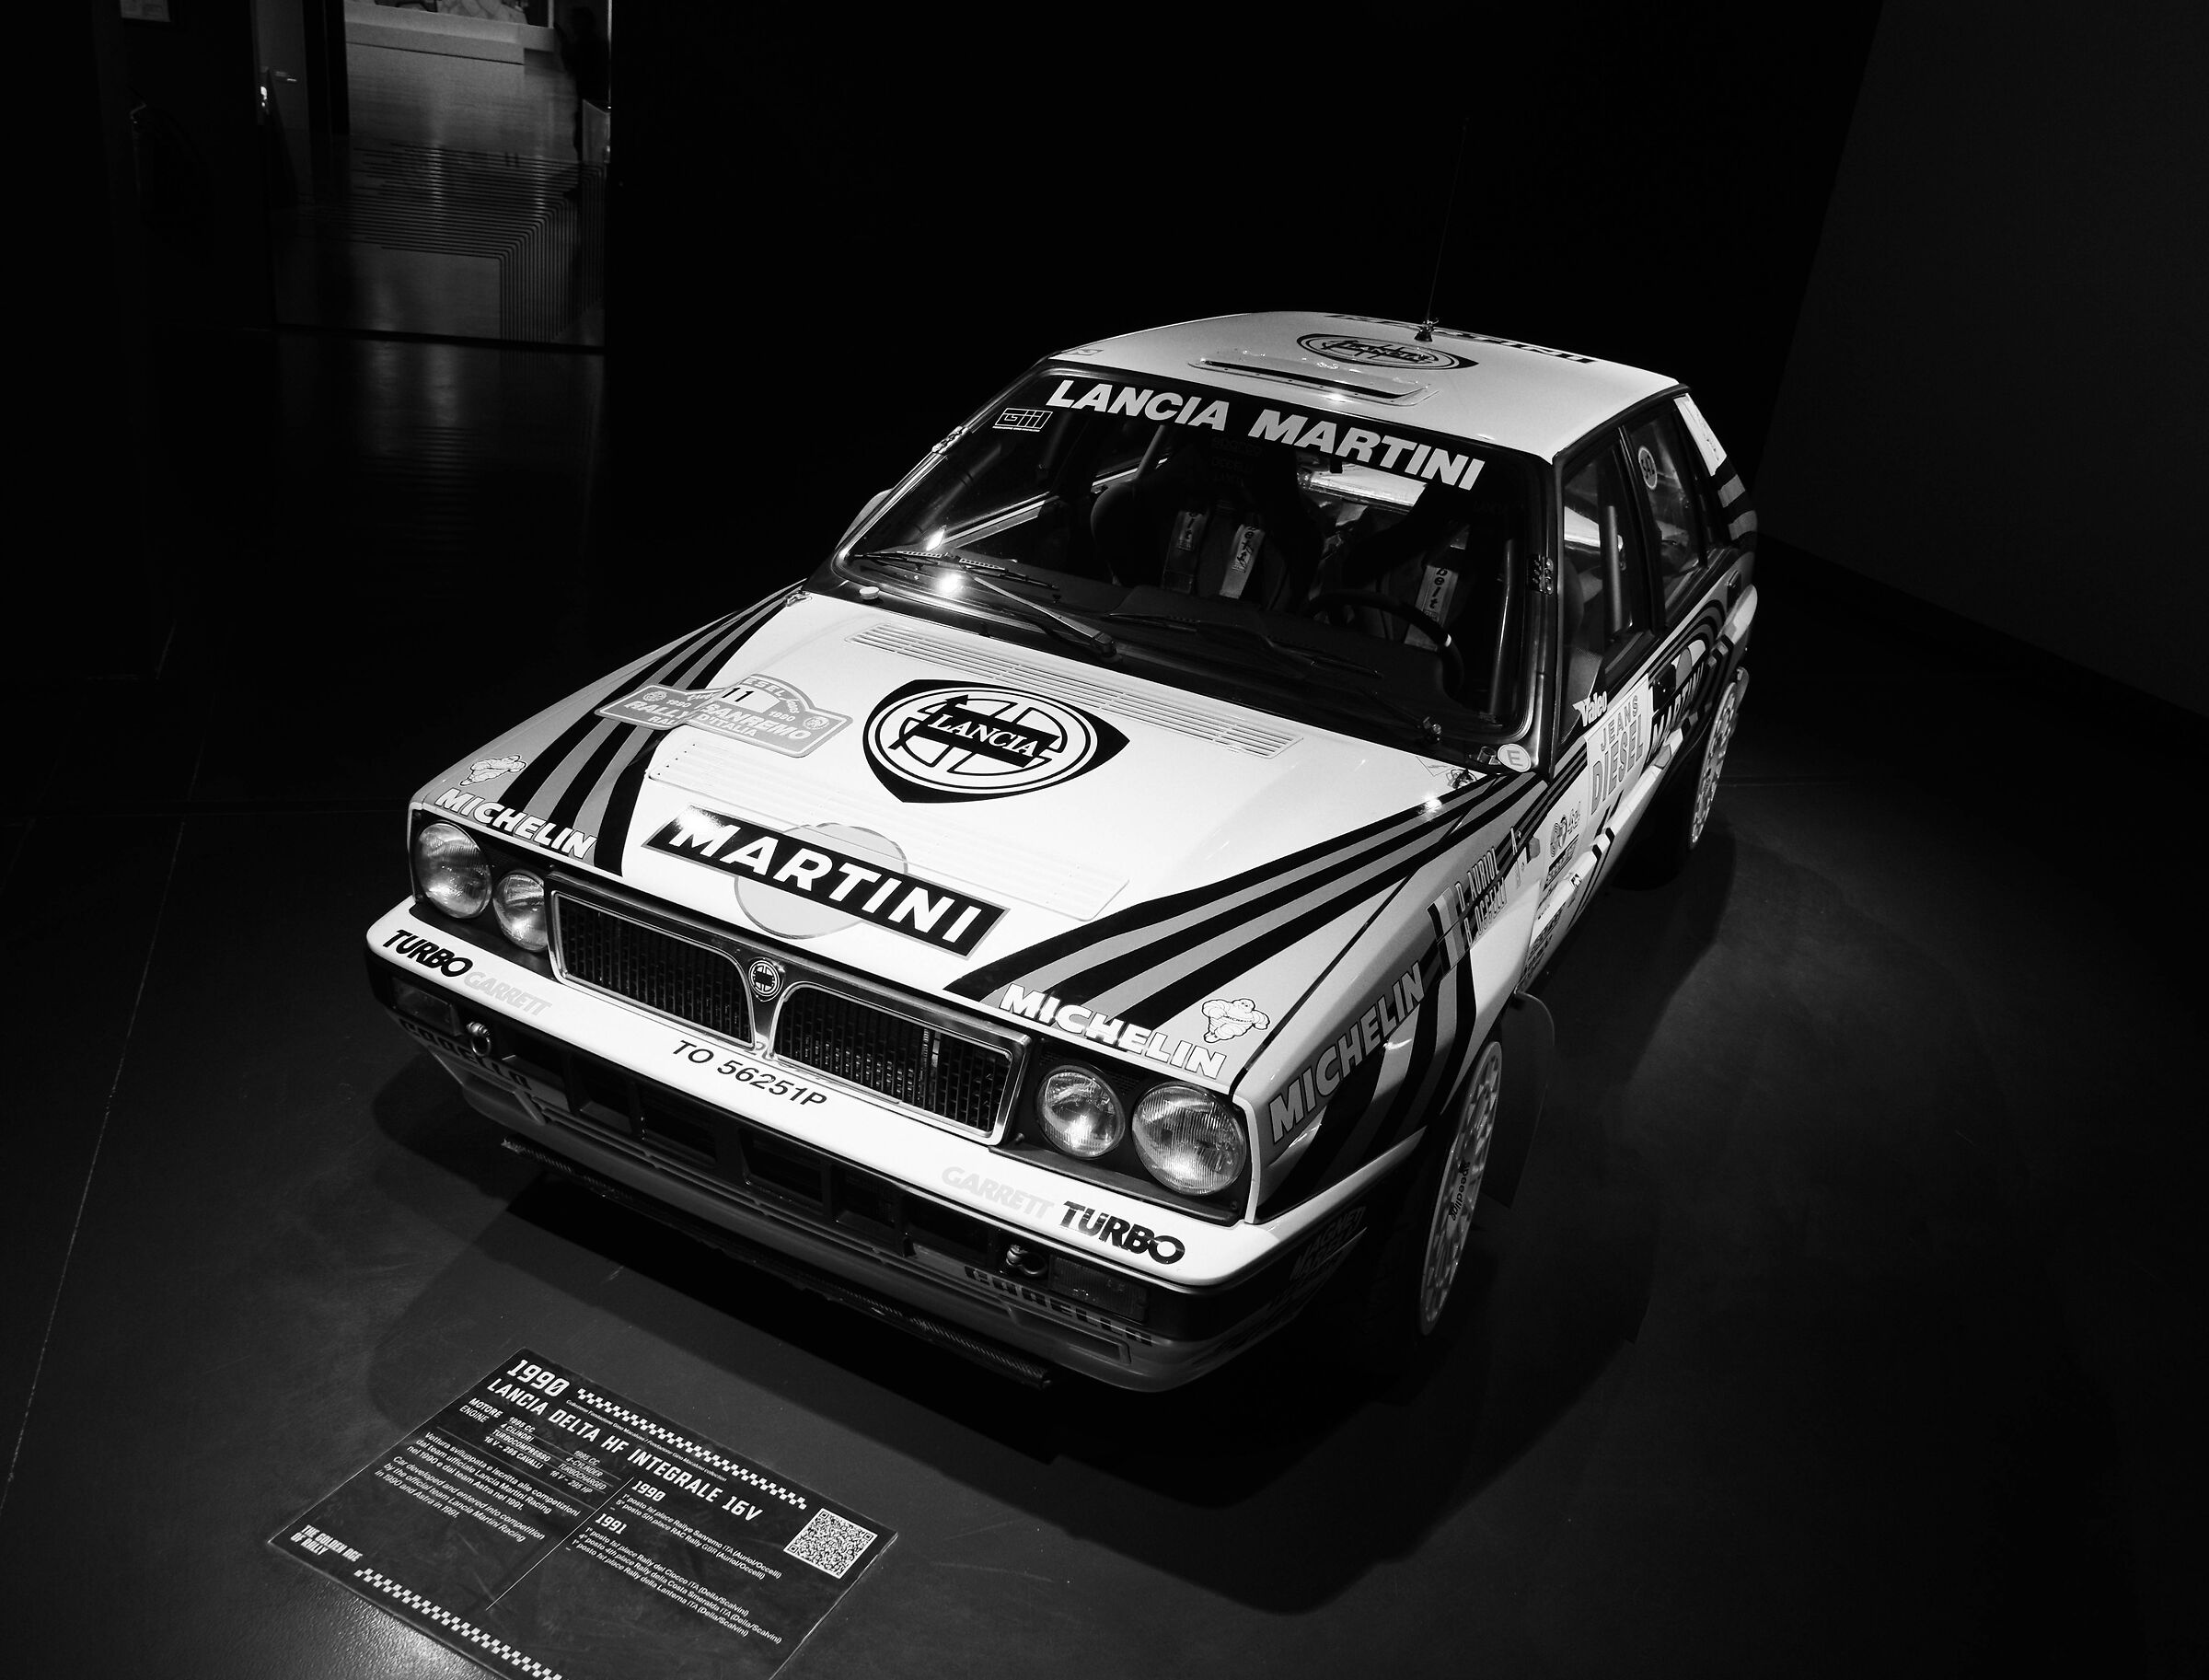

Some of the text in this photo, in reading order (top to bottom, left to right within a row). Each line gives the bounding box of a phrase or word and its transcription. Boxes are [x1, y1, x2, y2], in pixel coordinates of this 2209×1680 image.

[1047, 379, 1228, 432] LANCIA
[1247, 409, 1486, 491] MARTINI
[700, 703, 812, 739] SANREMO
[722, 687, 755, 702] 11
[697, 713, 758, 736] D'ITALIA
[927, 713, 1038, 758] LANCIA
[1601, 695, 1638, 751] JEANS
[1506, 749, 1524, 768] E
[1591, 713, 1644, 815] DIESEL
[434, 788, 598, 859] MICHELIN
[669, 811, 982, 943] MARTINI
[1467, 846, 1499, 902] AURIOL
[383, 929, 552, 1016] TURBO GARRETT
[998, 983, 1227, 1080] MICHELIN
[1269, 960, 1426, 1145] MICHELIN
[673, 1039, 827, 1106] TO 56251P
[941, 1165, 1185, 1265] GARRETT TURBO
[506, 1359, 570, 1396] 1990
[458, 1404, 490, 1423] ENGINE
[468, 1396, 503, 1418] MOTORE
[504, 1425, 535, 1442] CILINDRI
[523, 1424, 536, 1432] CC
[486, 1377, 763, 1521] LANCIA DELTA HF INTEGRALE 16V
[492, 1428, 551, 1462] TURBOCOMPRESSO
[515, 1452, 544, 1469] CAVALLI
[565, 1456, 603, 1477] 4-CYLINDER
[572, 1449, 600, 1466] 1995 CC
[382, 1473, 403, 1486] 1990
[399, 1483, 418, 1494] and
[411, 1490, 434, 1504] Astra
[432, 1500, 443, 1509] in
[440, 1504, 460, 1518] 1991.
[383, 1462, 526, 1542] by the official team Lancia Martini Racing
[392, 1455, 545, 1540] Car developed and entered into competition
[406, 1445, 422, 1455] nel
[418, 1451, 439, 1464] 1990
[441, 1464, 457, 1474] dal
[453, 1469, 474, 1484] team
[471, 1480, 494, 1495] Astra
[492, 1490, 508, 1500] nel
[504, 1496, 524, 1511] 1991.
[415, 1438, 552, 1514] dal team ufficiale Lancia Martini Racing
[424, 1431, 451, 1449] Vettura
[448, 1445, 487, 1468] sviluppata
[491, 1466, 518, 1485] iscritta
[516, 1481, 532, 1492] alle
[530, 1489, 581, 1517] competizioni
[557, 1462, 607, 1489] TURBOCHARGED
[567, 1478, 584, 1489] 295
[579, 1485, 593, 1493] HP
[630, 1479, 666, 1501] 1990
[290, 1531, 329, 1555] OF RALLY
[300, 1524, 320, 1538] THE
[314, 1532, 348, 1554] GOLDEN
[594, 1512, 627, 1535] 1991
[620, 1503, 642, 1516] posto
[650, 1518, 671, 1530] place
[669, 1526, 687, 1538] RAC
[684, 1534, 702, 1547] Rally
[714, 1550, 766, 1580] (Auriol/Occelli)
[626, 1496, 647, 1509] posto
[653, 1511, 675, 1523] place
[672, 1519, 694, 1533] Rallye
[692, 1529, 723, 1548] Sanremo
[721, 1544, 734, 1554] ITA
[731, 1549, 782, 1579] (Auriol/Occelli)
[575, 1542, 596, 1556] posto
[603, 1557, 625, 1570] place
[622, 1566, 642, 1580] Rally
[639, 1576, 657, 1588] della
[655, 1583, 688, 1605] Lanterna
[686, 1599, 699, 1610] ITA
[584, 1536, 606, 1550] posto
[604, 1547, 617, 1557] 4th
[613, 1553, 635, 1566] place
[632, 1561, 652, 1575] Rally
[650, 1571, 668, 1583] della
[666, 1580, 688, 1594] Costa
[687, 1590, 720, 1611] Smeralda
[718, 1606, 731, 1617] ITA
[588, 1530, 610, 1544] posto
[616, 1545, 638, 1558] place
[635, 1553, 654, 1567] Rally
[653, 1563, 666, 1572] del
[664, 1568, 688, 1584] Ciocco
[687, 1580, 700, 1591] ITA
